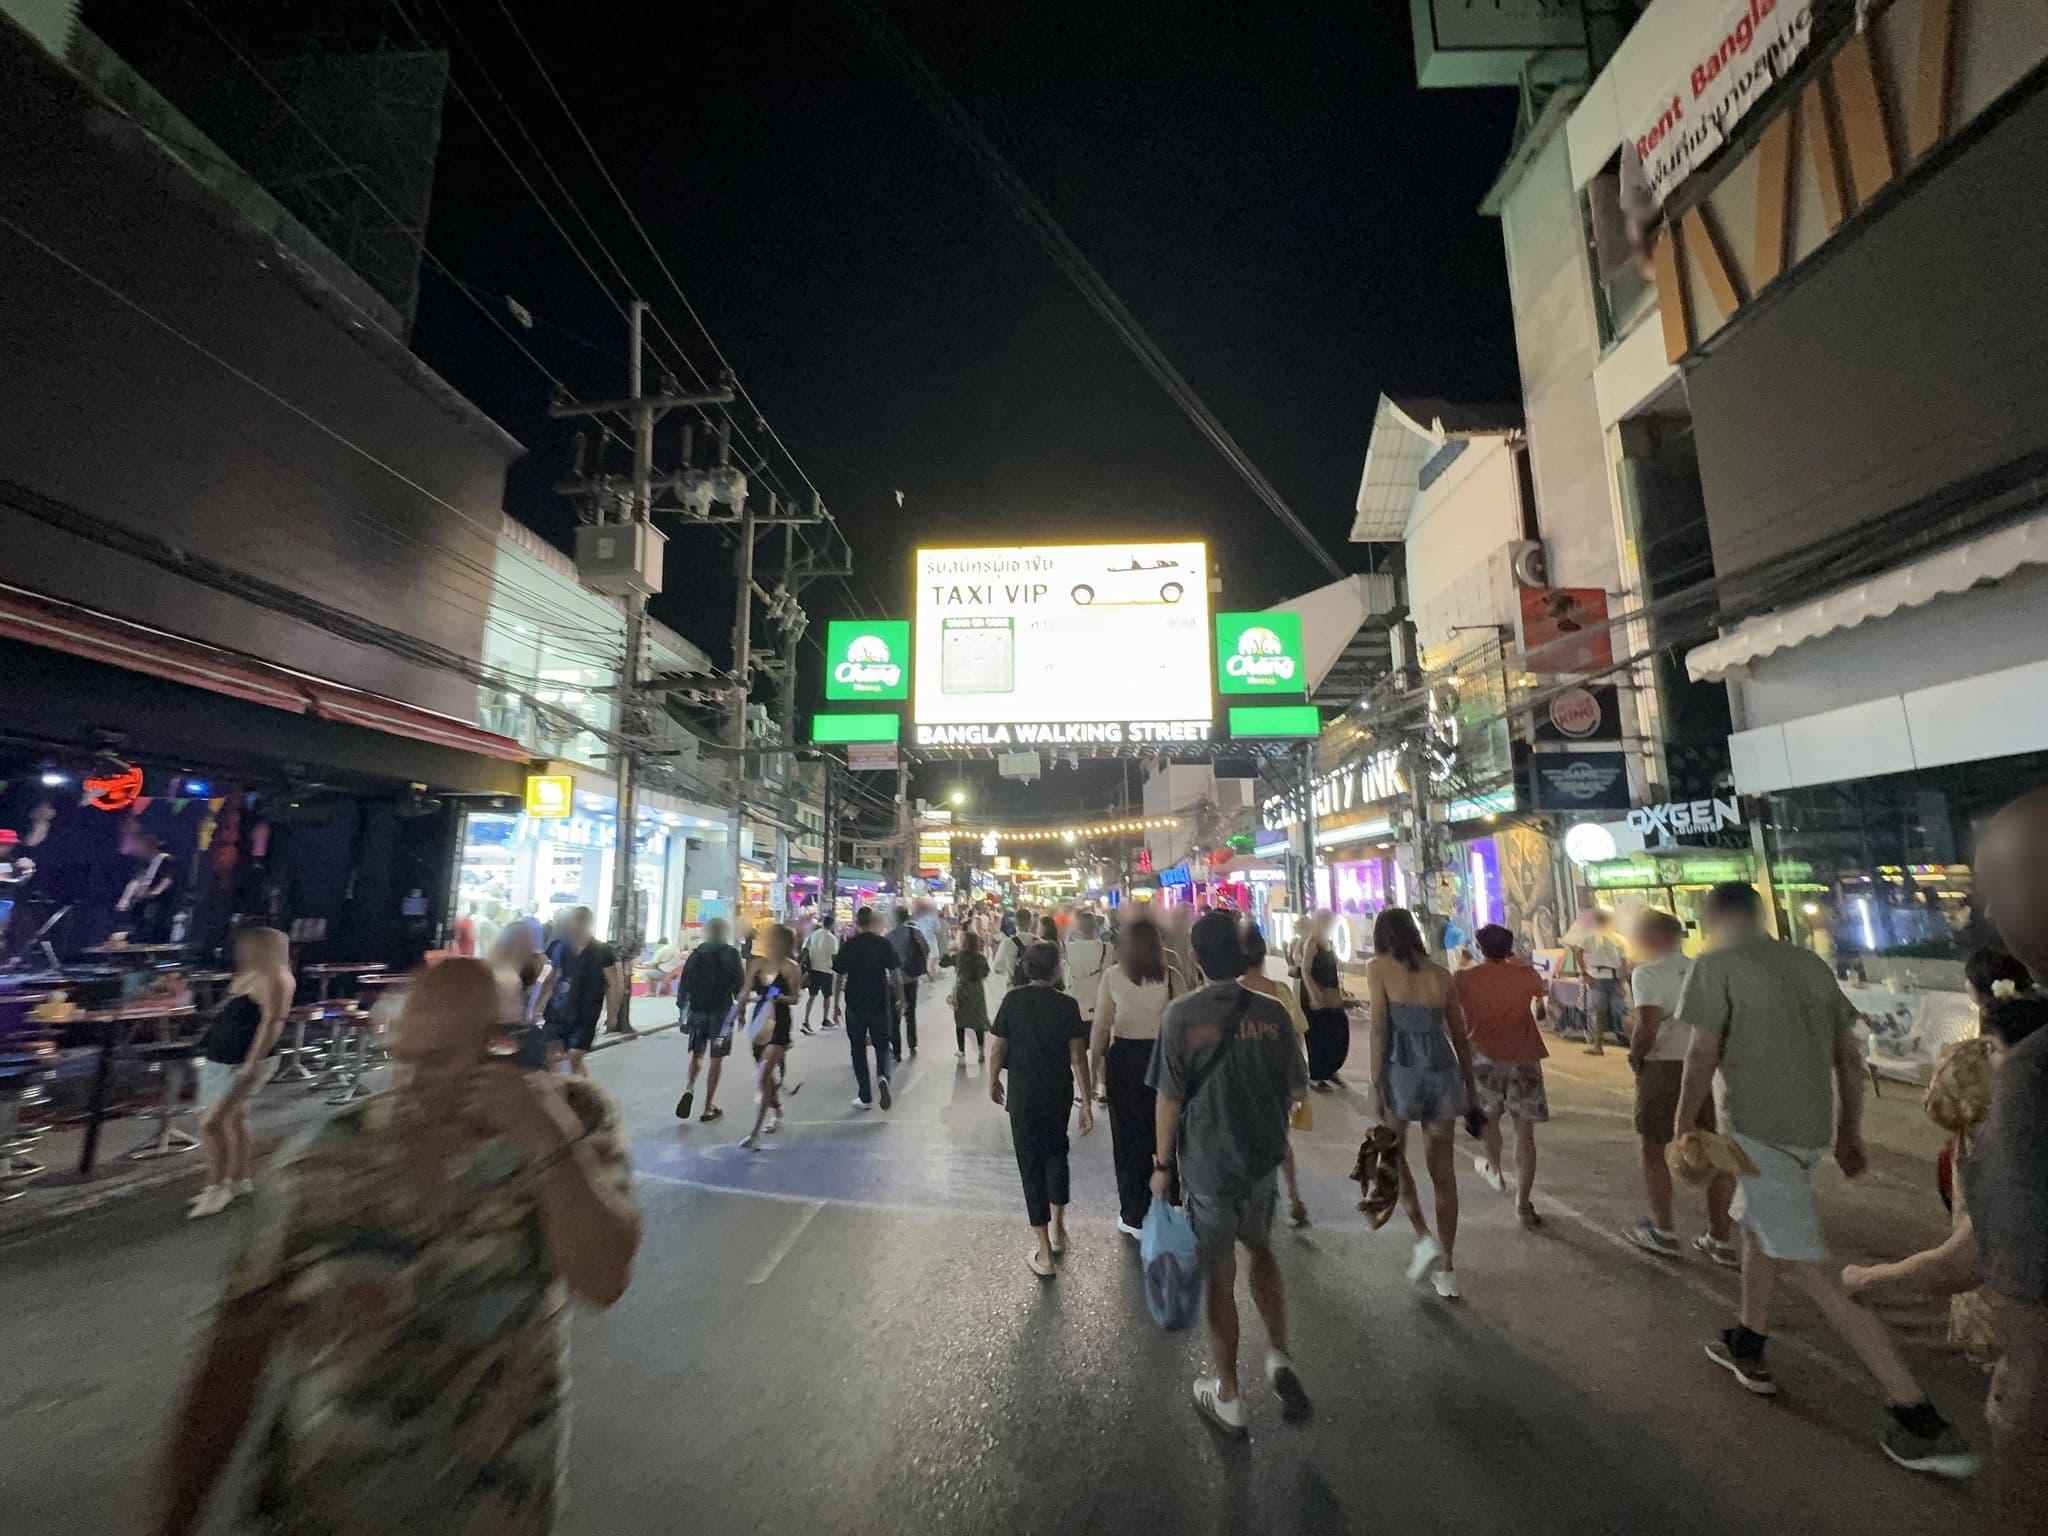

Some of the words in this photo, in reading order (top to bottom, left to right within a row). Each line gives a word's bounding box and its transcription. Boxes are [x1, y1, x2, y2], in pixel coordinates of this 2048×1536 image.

[1635, 95, 1684, 164] Rent
[932, 585, 992, 605] TAXI
[1005, 584, 1048, 604] VIP
[917, 724, 1011, 745] BANGLA
[1014, 722, 1122, 744] WALKING
[1128, 720, 1212, 742] STREET
